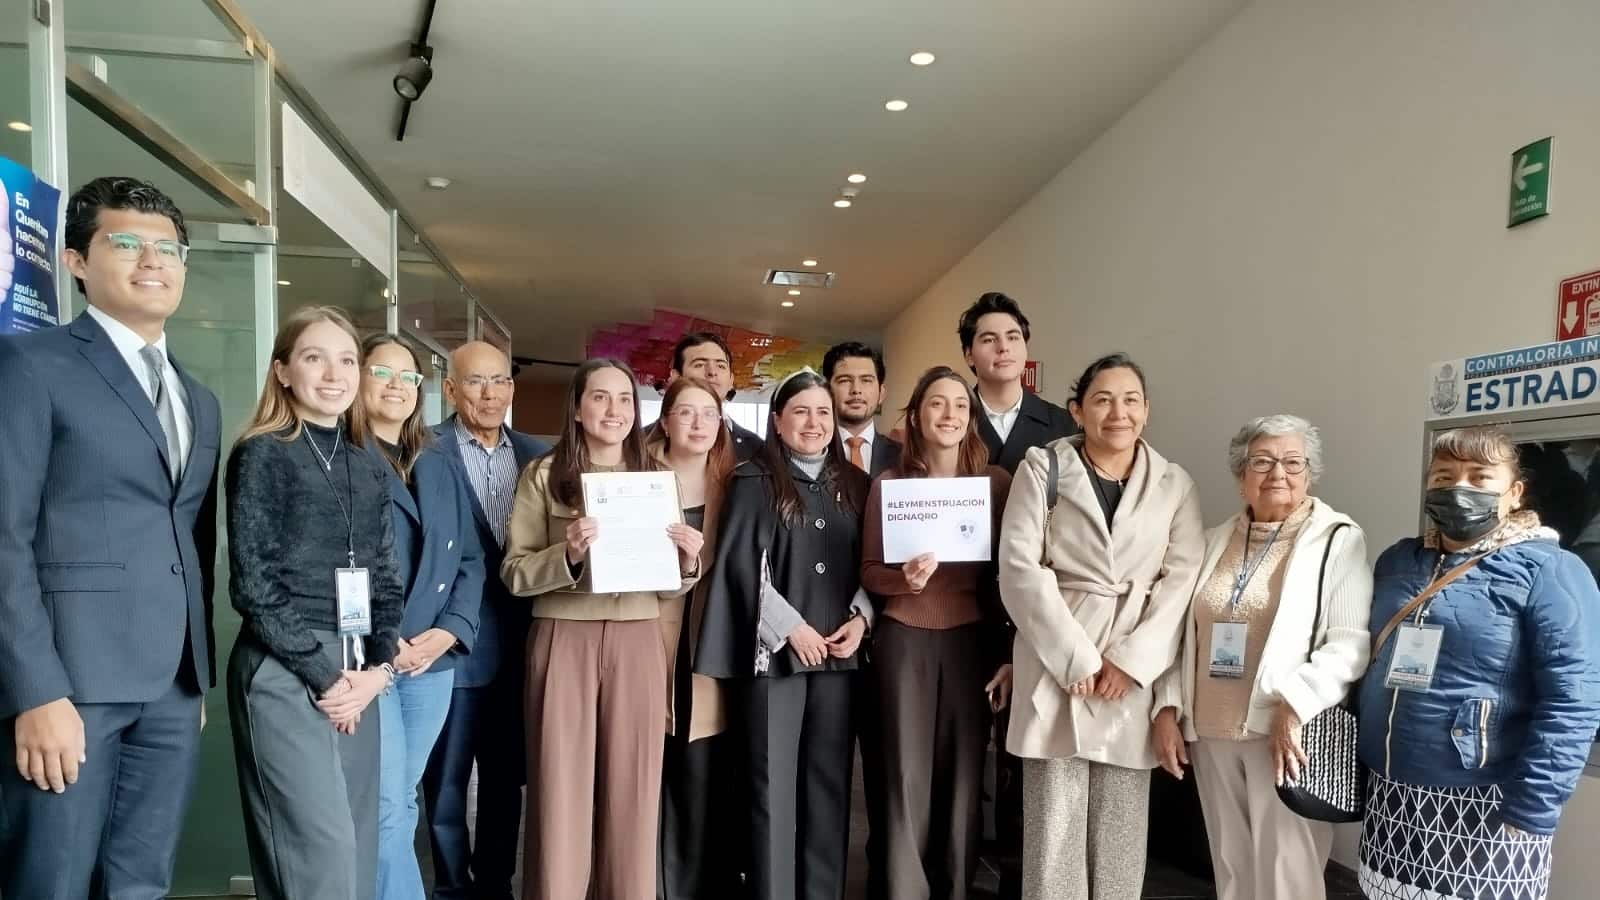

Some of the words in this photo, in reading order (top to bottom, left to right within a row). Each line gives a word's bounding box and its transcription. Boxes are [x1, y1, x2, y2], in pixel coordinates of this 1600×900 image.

[16, 192, 30, 210] En
[16, 242, 25, 257] lo
[13, 302, 22, 313] NO
[1466, 343, 1574, 373] CONTRALORÍA
[1466, 366, 1600, 412] ESTRAD
[887, 498, 985, 509] #LEYMENSTRUACION
[887, 512, 938, 522] DIGNAQRO
